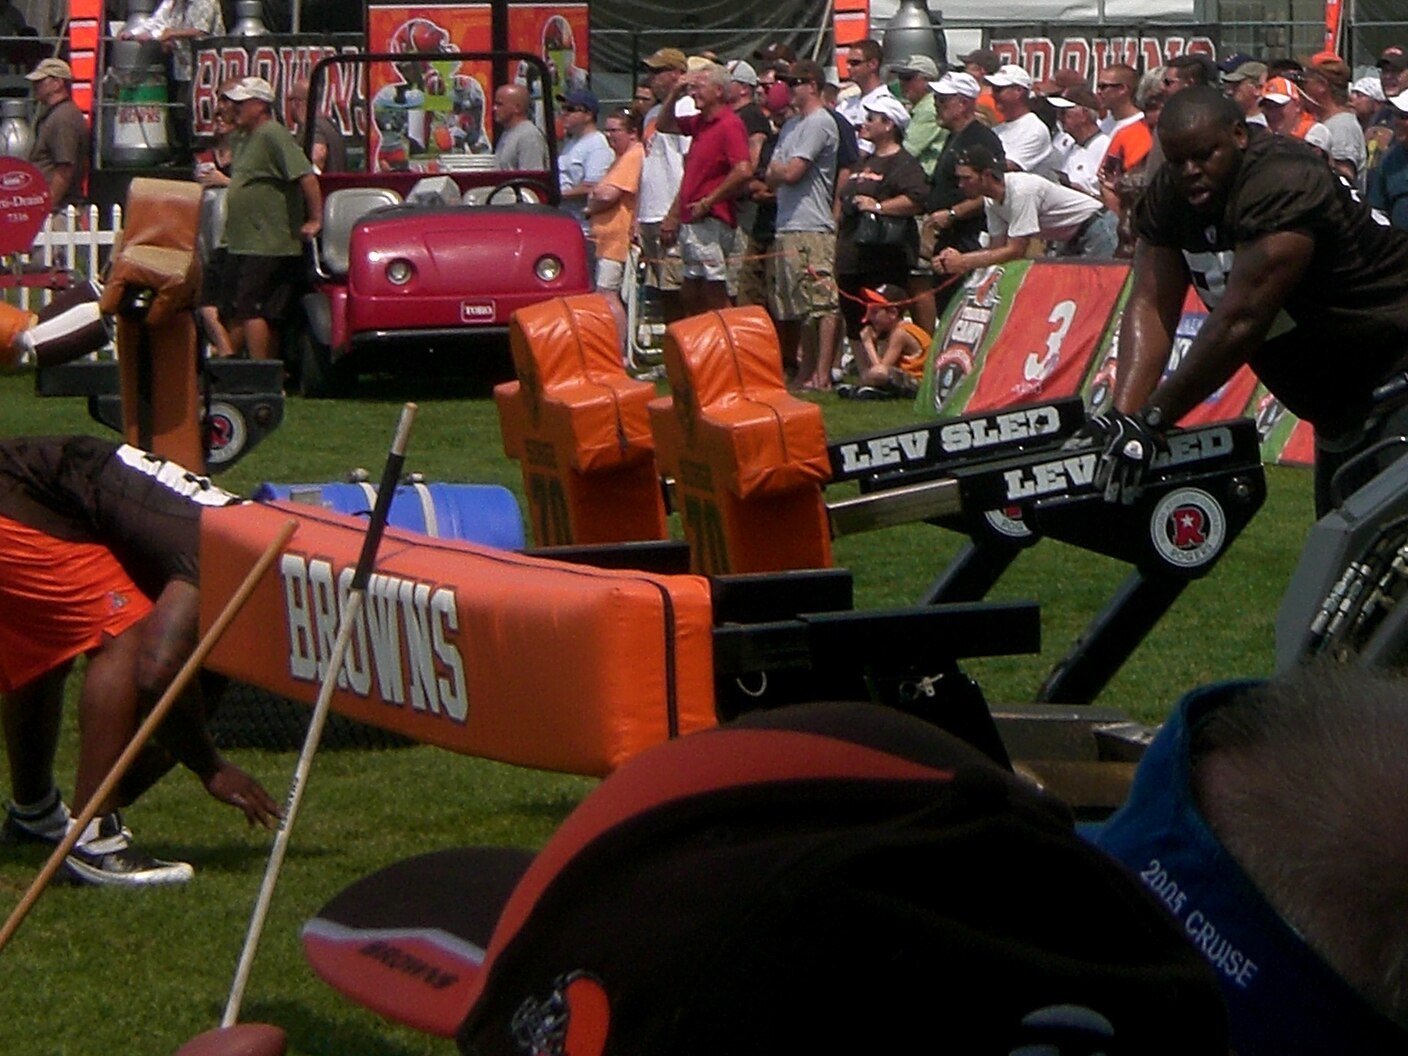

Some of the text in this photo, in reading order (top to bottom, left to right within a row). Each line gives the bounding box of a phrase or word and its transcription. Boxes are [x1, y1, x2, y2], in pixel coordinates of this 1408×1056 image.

[465, 305, 492, 316] TORO
[1024, 299, 1077, 382] 3
[840, 405, 1061, 472] LEV SLED
[1003, 453, 1099, 501] LEV
[280, 551, 469, 723] BROWNS
[1139, 859, 1259, 989] 2005 CRUISE
[359, 940, 459, 990] BROWNS
